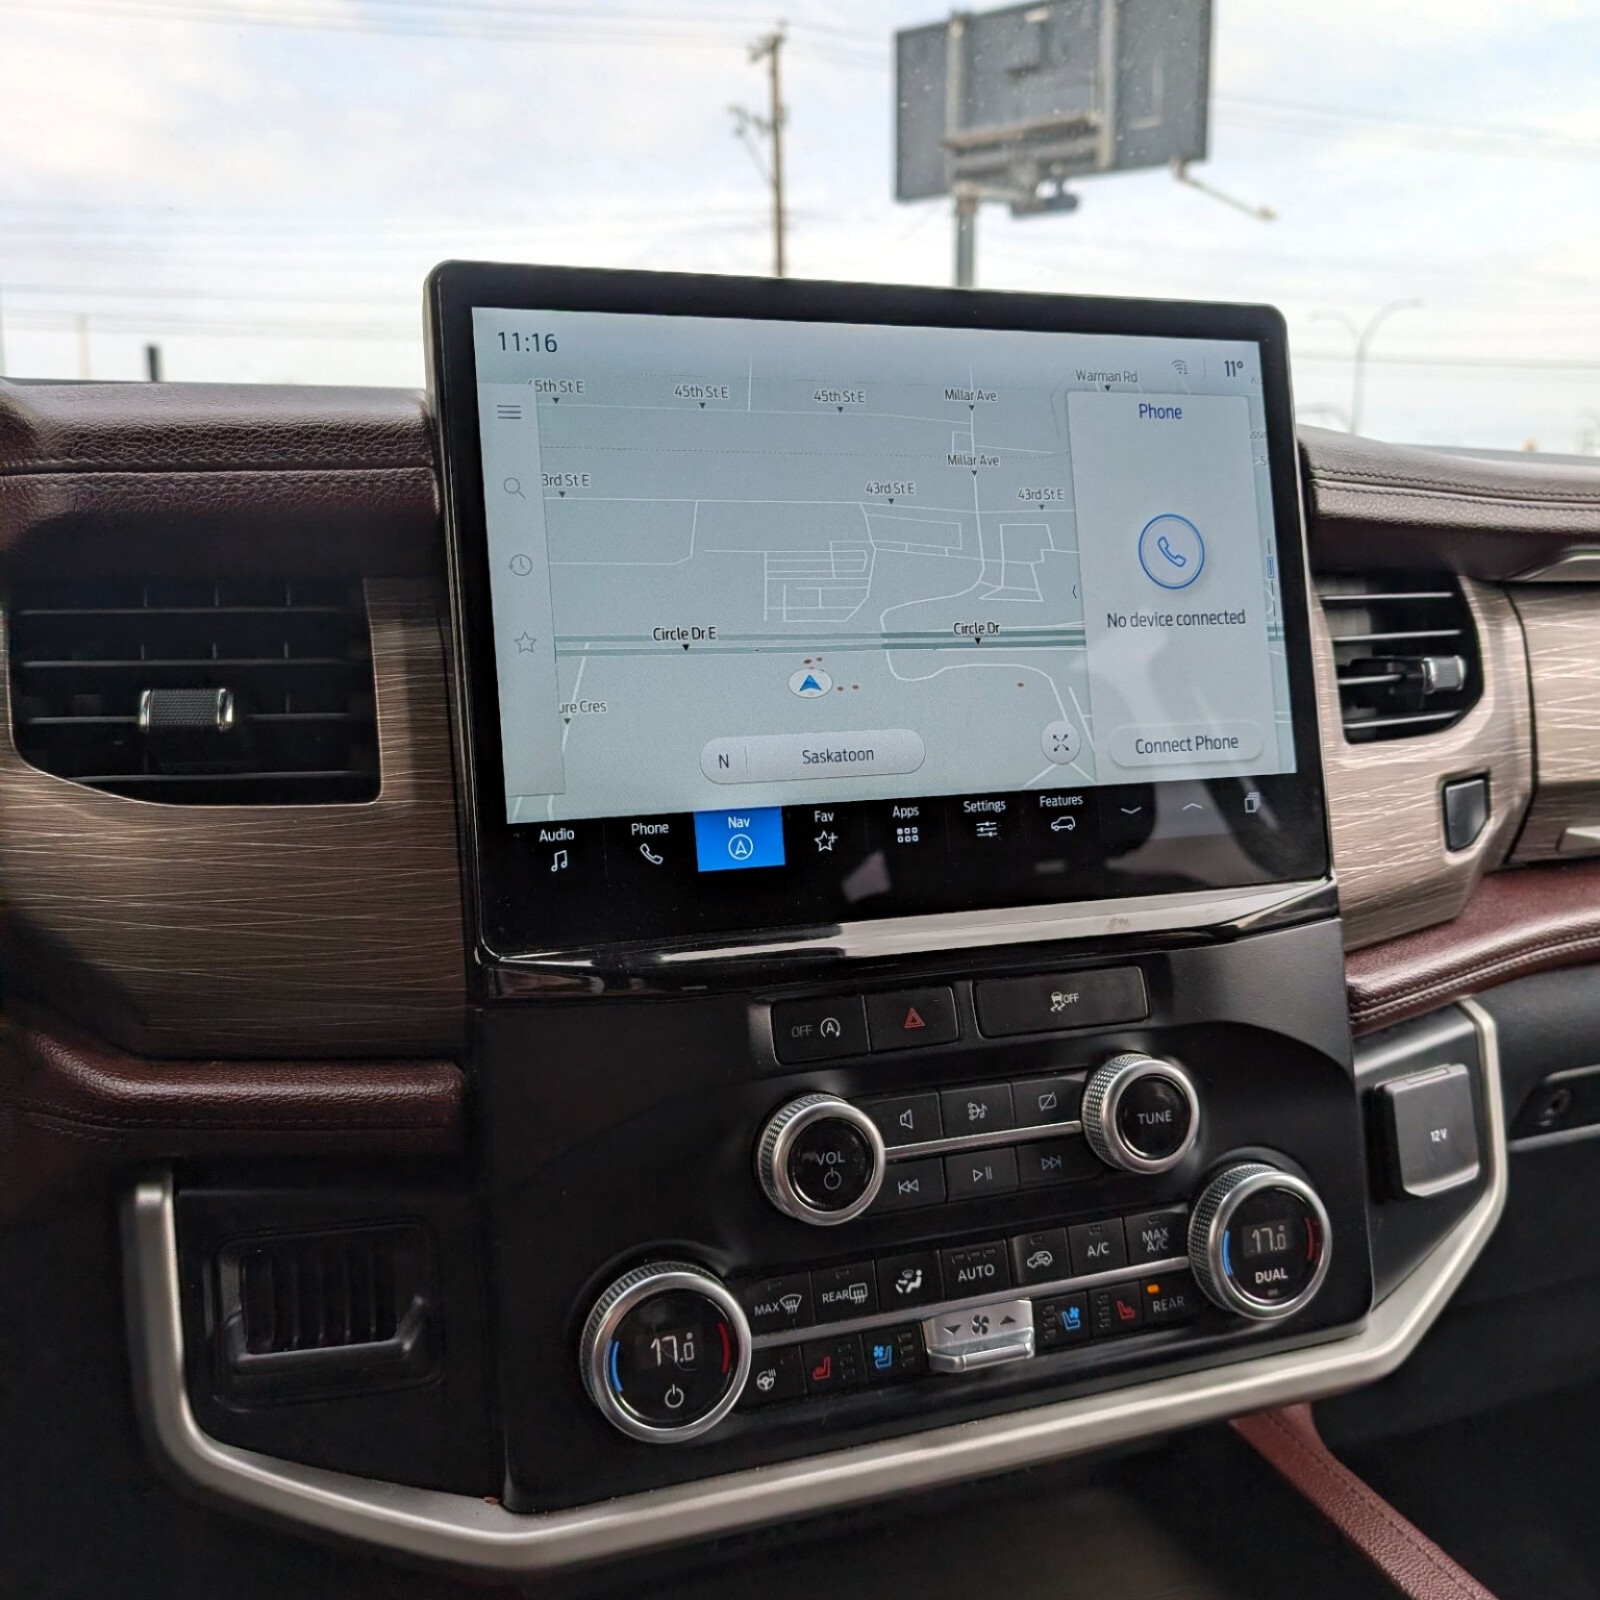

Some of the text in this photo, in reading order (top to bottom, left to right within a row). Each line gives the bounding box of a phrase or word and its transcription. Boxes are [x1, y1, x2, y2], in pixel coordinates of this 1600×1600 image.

[497, 331, 558, 353] 11:16
[1224, 359, 1244, 378] 11°
[1075, 370, 1138, 383] Warman Rd
[528, 379, 584, 393] 5th St E
[674, 386, 728, 399] 45th St E
[813, 390, 865, 403] 45th St E
[944, 389, 997, 402] Millar Ave
[1138, 403, 1183, 420] Phone
[947, 455, 999, 467] Millar Ave
[564, 474, 579, 487] St
[582, 475, 590, 487] E
[865, 483, 915, 495] 43rd St E
[1018, 489, 1064, 501] 43rd St E
[1107, 608, 1246, 628] No device connected
[652, 626, 717, 641] Circle Dr E
[953, 622, 1001, 635] Circle Dr
[579, 700, 607, 713] Cres
[1134, 734, 1240, 755] Connect Phone
[718, 754, 730, 769] N
[802, 748, 875, 765] Saskatoon
[963, 800, 1007, 815] Settings
[1038, 793, 1084, 809] Features
[814, 809, 835, 823] Fav
[892, 804, 920, 820] Apps
[630, 821, 670, 837] Phone
[727, 816, 751, 829] Nav
[538, 827, 576, 843] Audio
[1062, 992, 1080, 1004] OFF
[791, 1024, 814, 1038] OFF
[1137, 1109, 1173, 1125] TUNE
[815, 1151, 845, 1166] VOL
[1142, 1227, 1170, 1243] MAX
[1087, 1241, 1111, 1258] A/C
[1146, 1237, 1169, 1253] A/C
[957, 1264, 996, 1283] AUTO
[1254, 1267, 1289, 1284] DUAL
[821, 1290, 849, 1303] REAR
[754, 1301, 780, 1317] MAX
[1152, 1295, 1186, 1314] REAR
